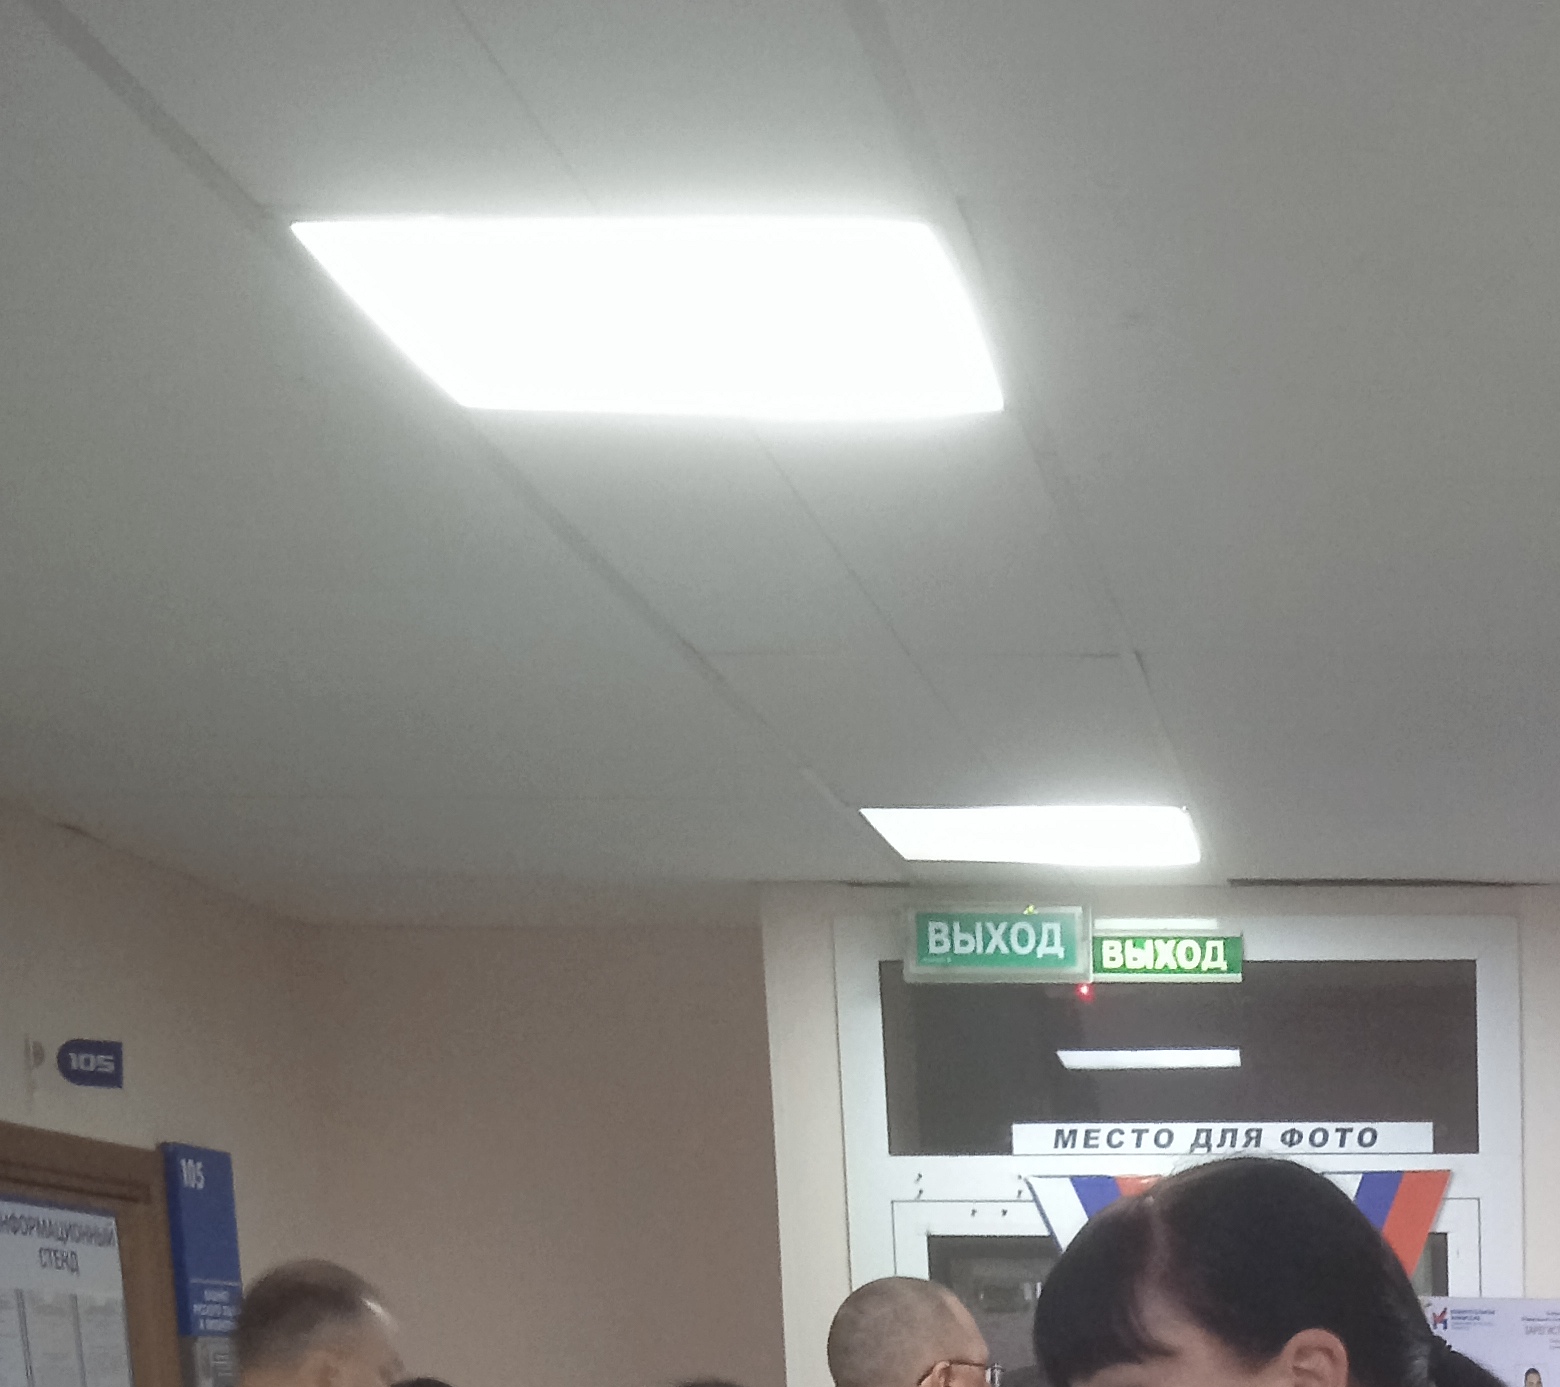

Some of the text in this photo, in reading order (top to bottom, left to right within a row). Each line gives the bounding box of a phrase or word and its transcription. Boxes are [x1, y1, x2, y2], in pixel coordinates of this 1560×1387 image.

[926, 921, 1065, 959] ВЫХОД
[1101, 939, 1228, 971] ВЫХОД
[68, 1051, 115, 1074] 105
[1053, 1127, 1379, 1154] МЕСТО ДЛЯ ФОТО
[180, 1158, 205, 1190] 105
